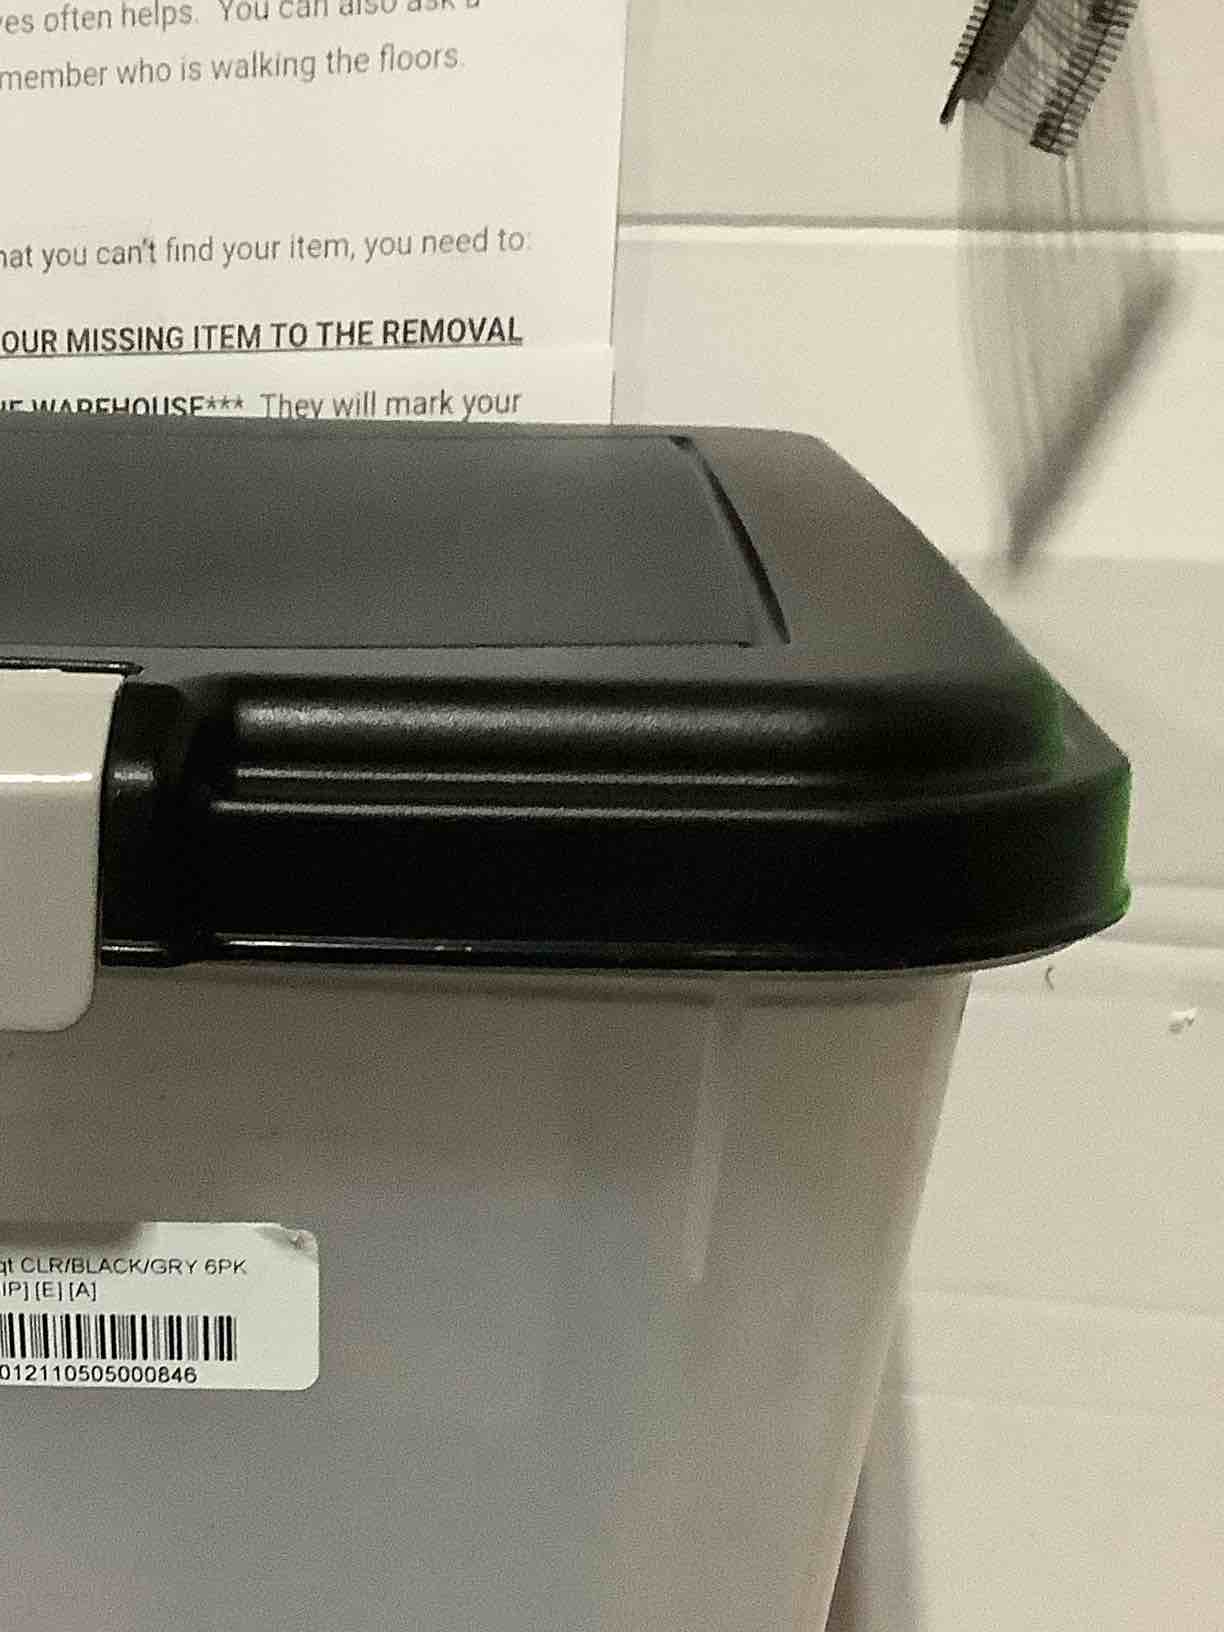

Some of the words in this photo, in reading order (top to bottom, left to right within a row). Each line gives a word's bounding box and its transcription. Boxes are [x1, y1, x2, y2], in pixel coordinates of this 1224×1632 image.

[43, 3, 112, 32] often
[121, 0, 198, 31] helps.
[219, 0, 269, 21] You
[279, 0, 328, 19] can
[117, 57, 171, 85] who
[181, 56, 202, 82] is
[211, 50, 317, 83] walking
[326, 47, 370, 75] the
[380, 42, 466, 73] floors.
[42, 244, 87, 274] you
[96, 238, 157, 266] can't
[166, 236, 213, 262] find
[222, 239, 280, 269] your
[290, 233, 356, 260] item,
[364, 233, 412, 263] you
[422, 226, 488, 254] need
[66, 324, 185, 353] MISSING
[193, 323, 261, 350] ITEM
[271, 321, 309, 348] TO
[317, 318, 374, 346] THE
[383, 315, 523, 344] REMOVAL
[260, 393, 324, 419] They
[332, 390, 376, 417] will
[386, 390, 455, 416] mark
[464, 392, 523, 422] your
[20, 1257, 197, 1275] CLR/BLACK/GRY
[204, 1259, 247, 1275] 6PK
[35, 1282, 63, 1301] [E]
[69, 1282, 97, 1301] [A]
